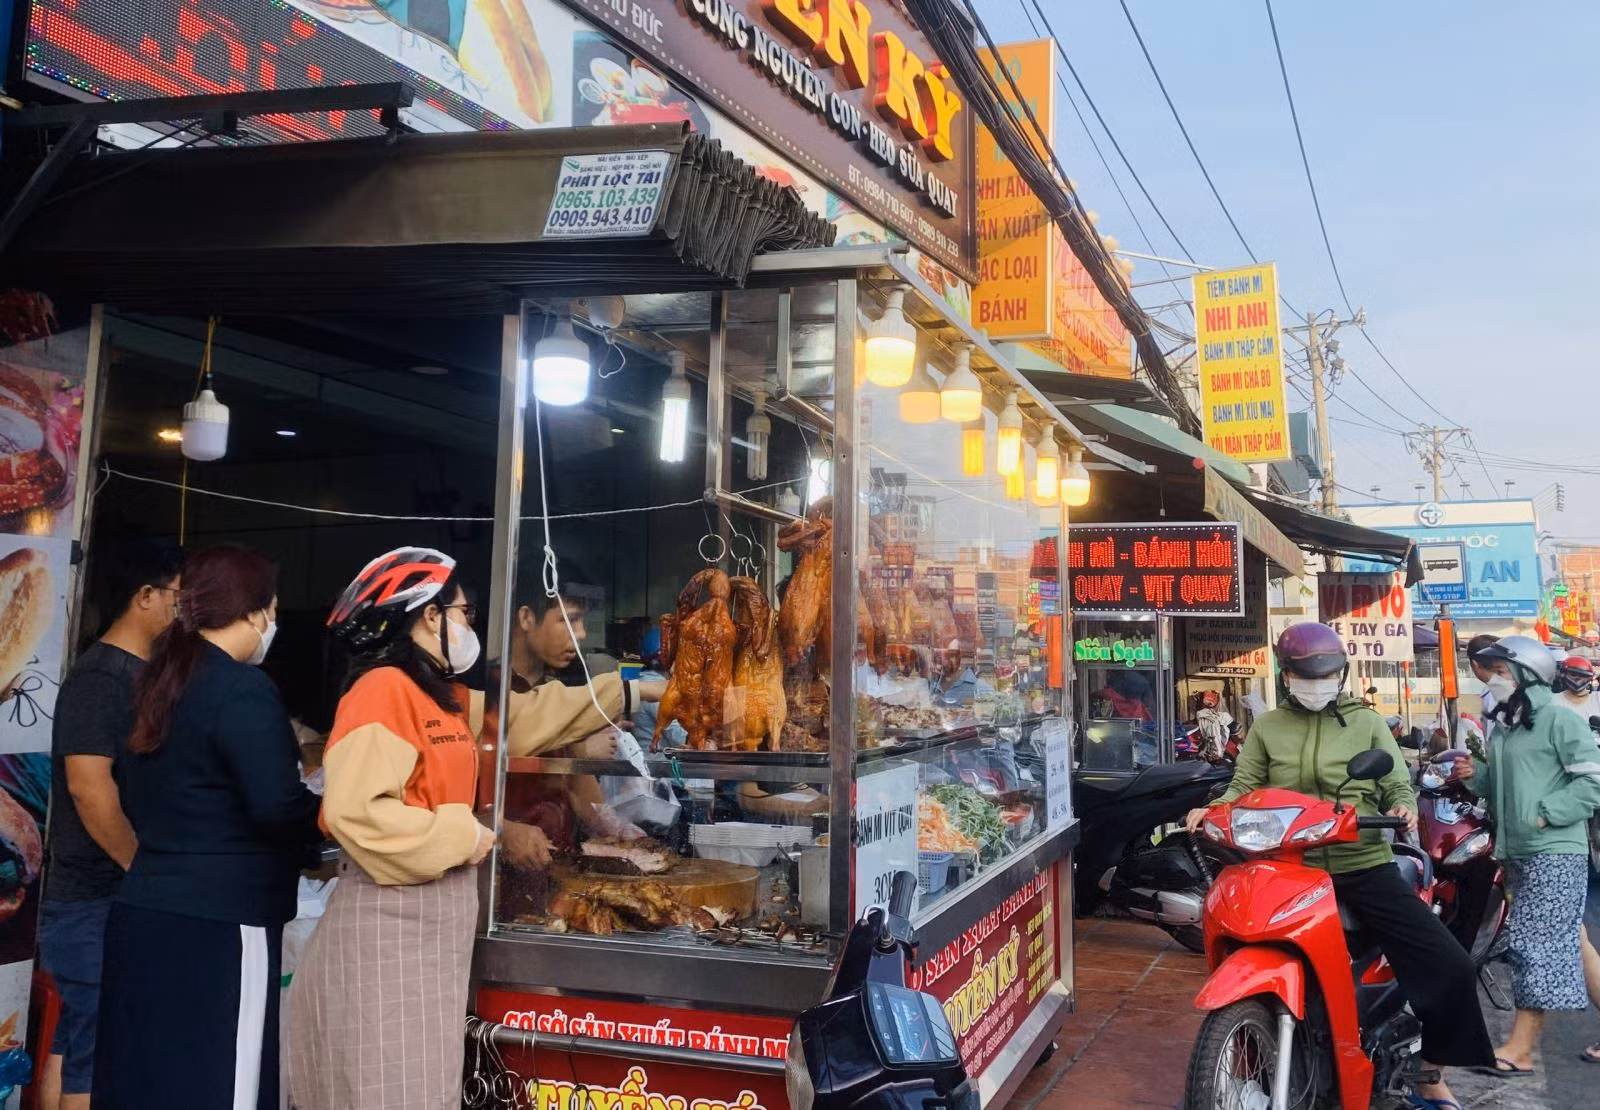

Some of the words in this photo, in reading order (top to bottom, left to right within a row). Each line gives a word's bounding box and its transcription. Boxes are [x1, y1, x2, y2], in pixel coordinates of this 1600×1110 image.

[754, 25, 827, 112] NGUYÊN
[831, 92, 861, 140] CON
[869, 121, 896, 166] HEO
[928, 172, 958, 217] QUAY
[561, 174, 600, 188] PHÁT
[603, 172, 633, 188] LỘC
[556, 187, 658, 208] 0965.103.439
[549, 206, 653, 227] 0909.943.410
[979, 210, 998, 241] ẢN
[1003, 206, 1041, 239] XUẤT
[980, 253, 1000, 282] ÁC
[1004, 255, 1038, 284] LOẠI
[979, 293, 1027, 323] BÁNH
[1205, 306, 1232, 332] NHI
[1237, 301, 1268, 329] ANH
[1133, 536, 1191, 568] BÁNH
[1196, 532, 1233, 568] HỎI
[1480, 560, 1521, 583] AN
[1074, 575, 1124, 604] QUAY
[1142, 575, 1175, 607] VỊT
[1180, 575, 1233, 605] QUAY
[1378, 571, 1405, 618] VỎ
[1350, 622, 1378, 636] TAY
[1384, 622, 1408, 637] GA
[1113, 640, 1154, 668] Sạch
[1254, 651, 1266, 666] GA
[1363, 639, 1385, 657] TÔ
[884, 810, 897, 843] VỊT
[944, 948, 997, 1041] UYỀN
[569, 1012, 616, 1040] SẢN
[618, 1018, 685, 1047] XUẤT
[763, 1033, 791, 1059] M
